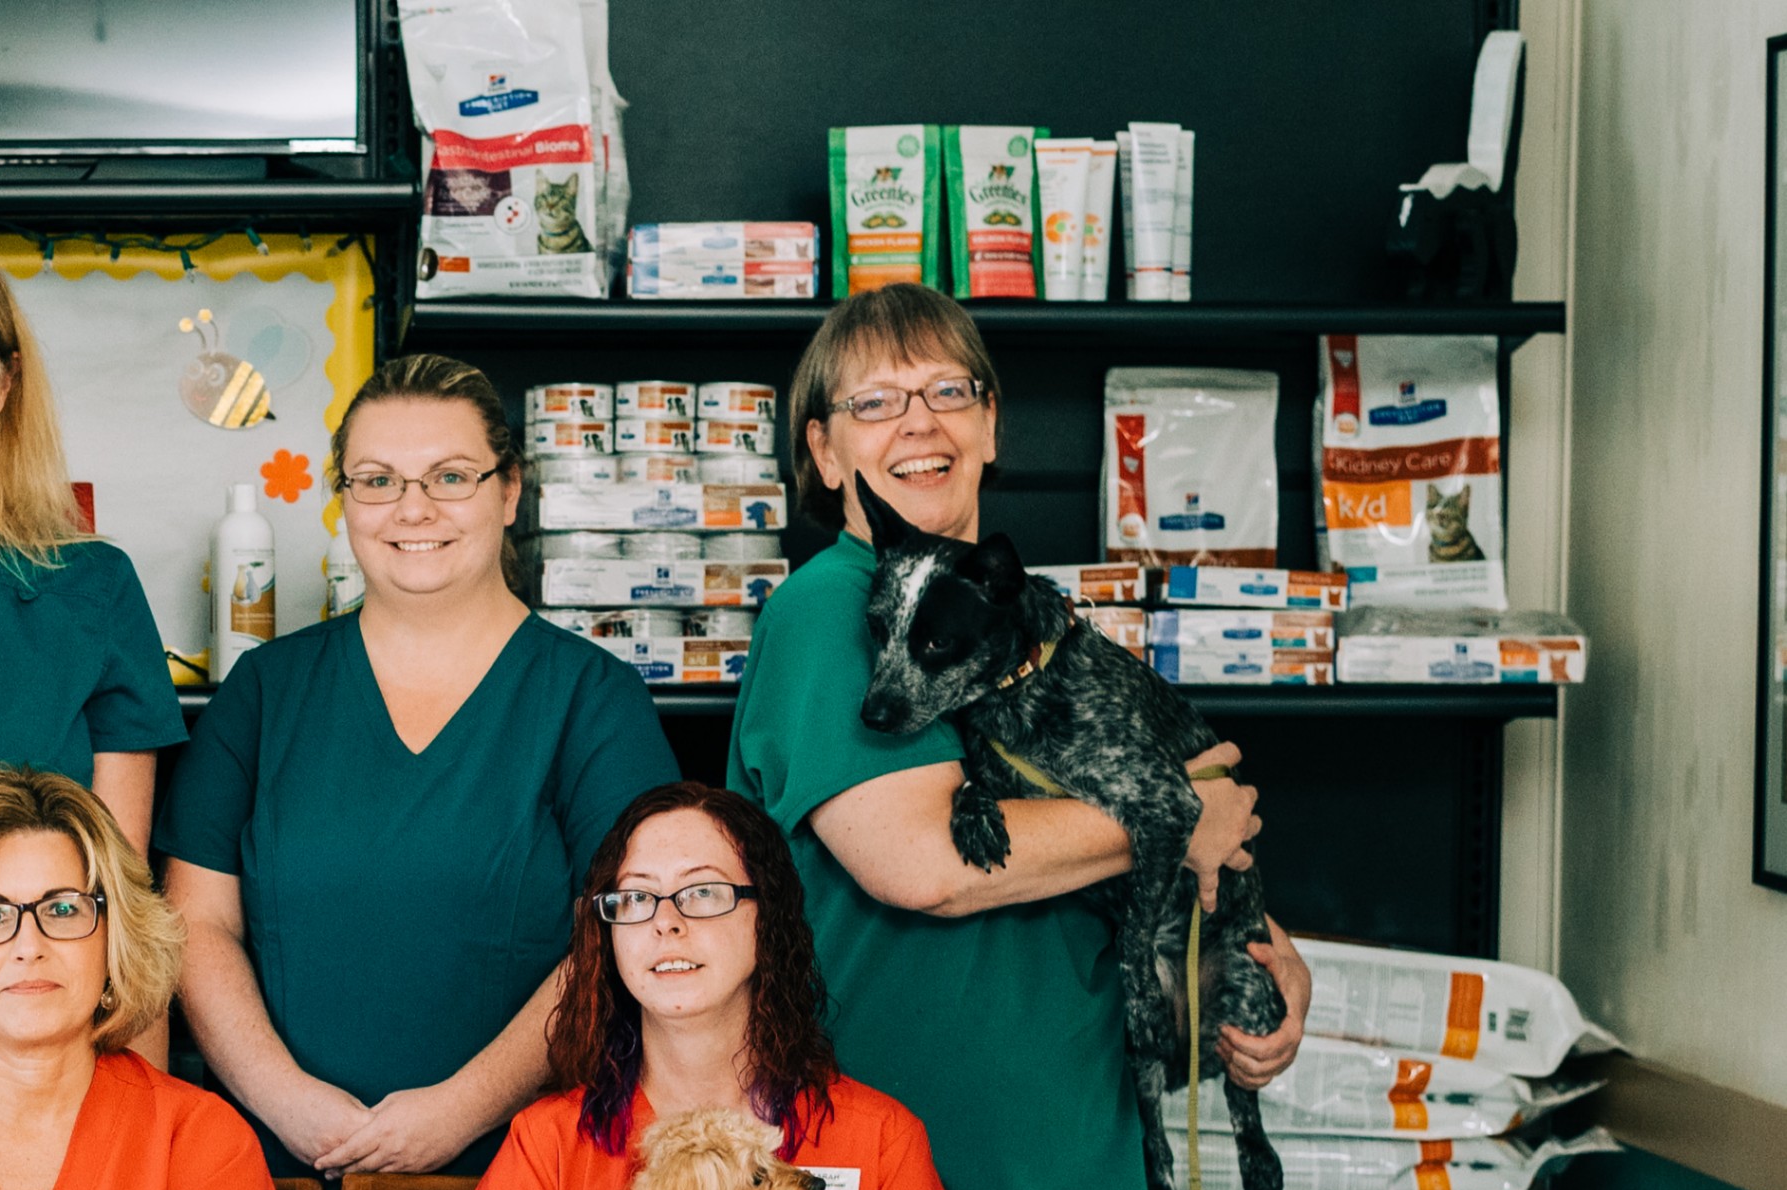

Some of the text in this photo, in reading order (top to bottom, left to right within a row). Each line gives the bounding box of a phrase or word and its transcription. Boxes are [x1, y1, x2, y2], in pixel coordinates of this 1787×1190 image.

[437, 140, 579, 161] astrointestinal Biome
[851, 184, 915, 208] Greenies
[969, 183, 1027, 206] Greenies
[1333, 452, 1450, 475] Kidney Care
[1338, 493, 1387, 519] k/d
